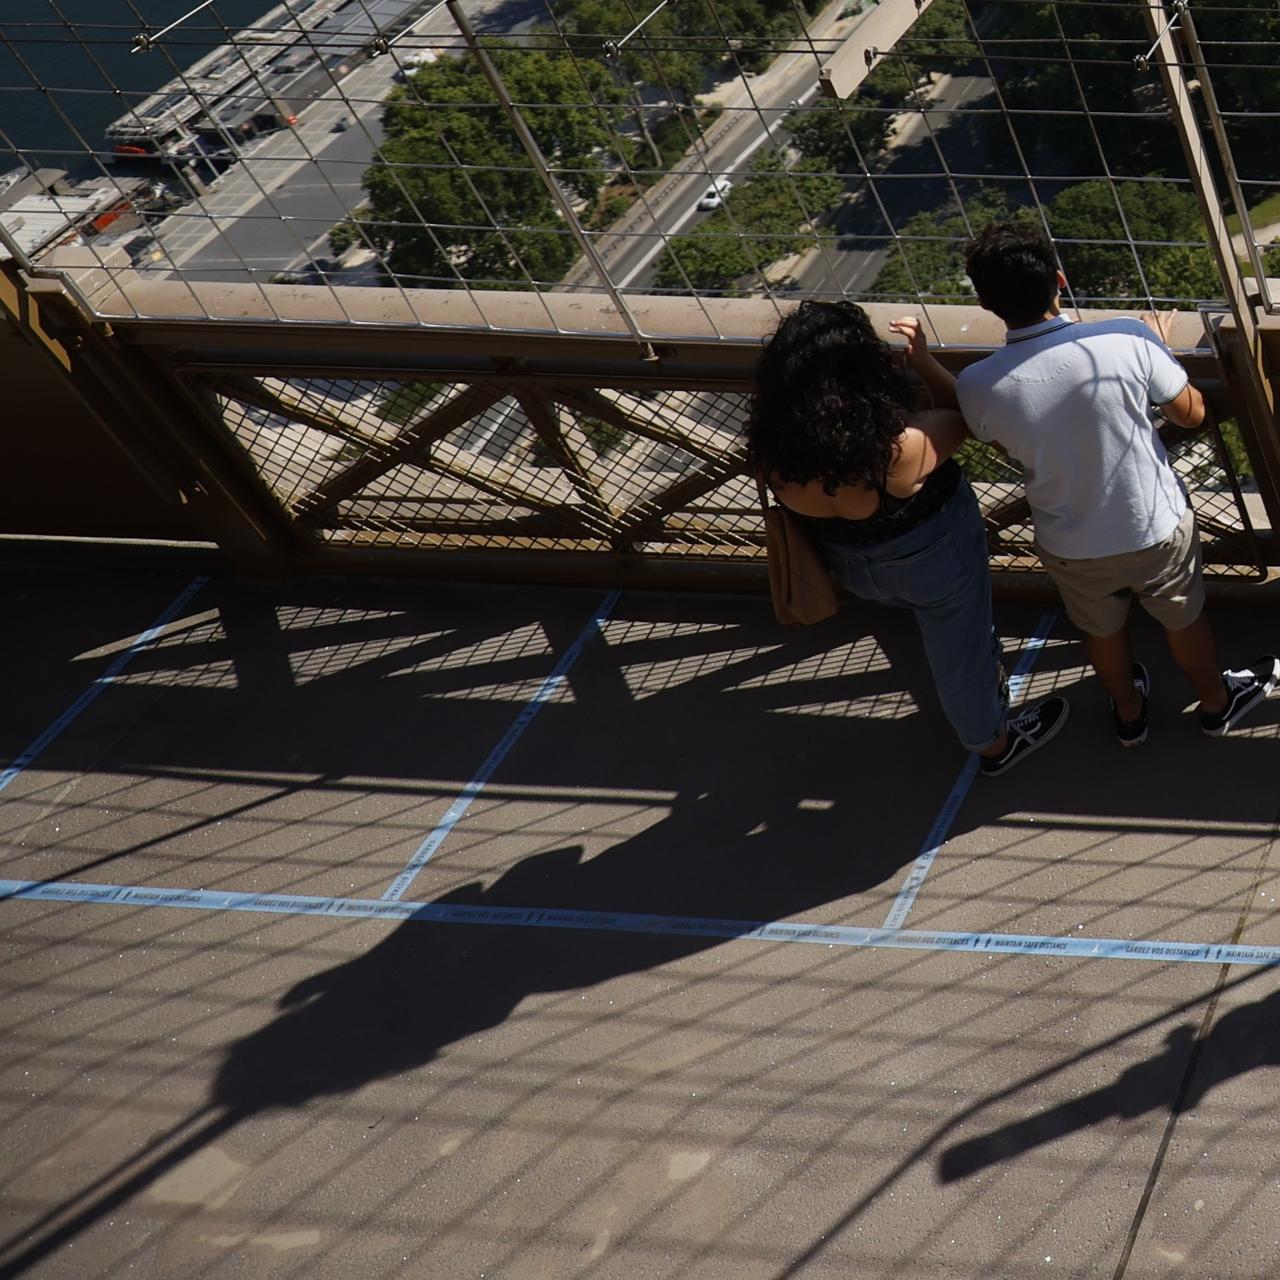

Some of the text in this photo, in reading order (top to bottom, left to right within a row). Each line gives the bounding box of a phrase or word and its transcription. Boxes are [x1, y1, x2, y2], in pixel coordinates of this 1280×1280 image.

[993, 939, 1067, 951] MAINTAIN SAFE DISTANCE
[1125, 945, 1201, 957] GARDEZ VOS DISTANCES
